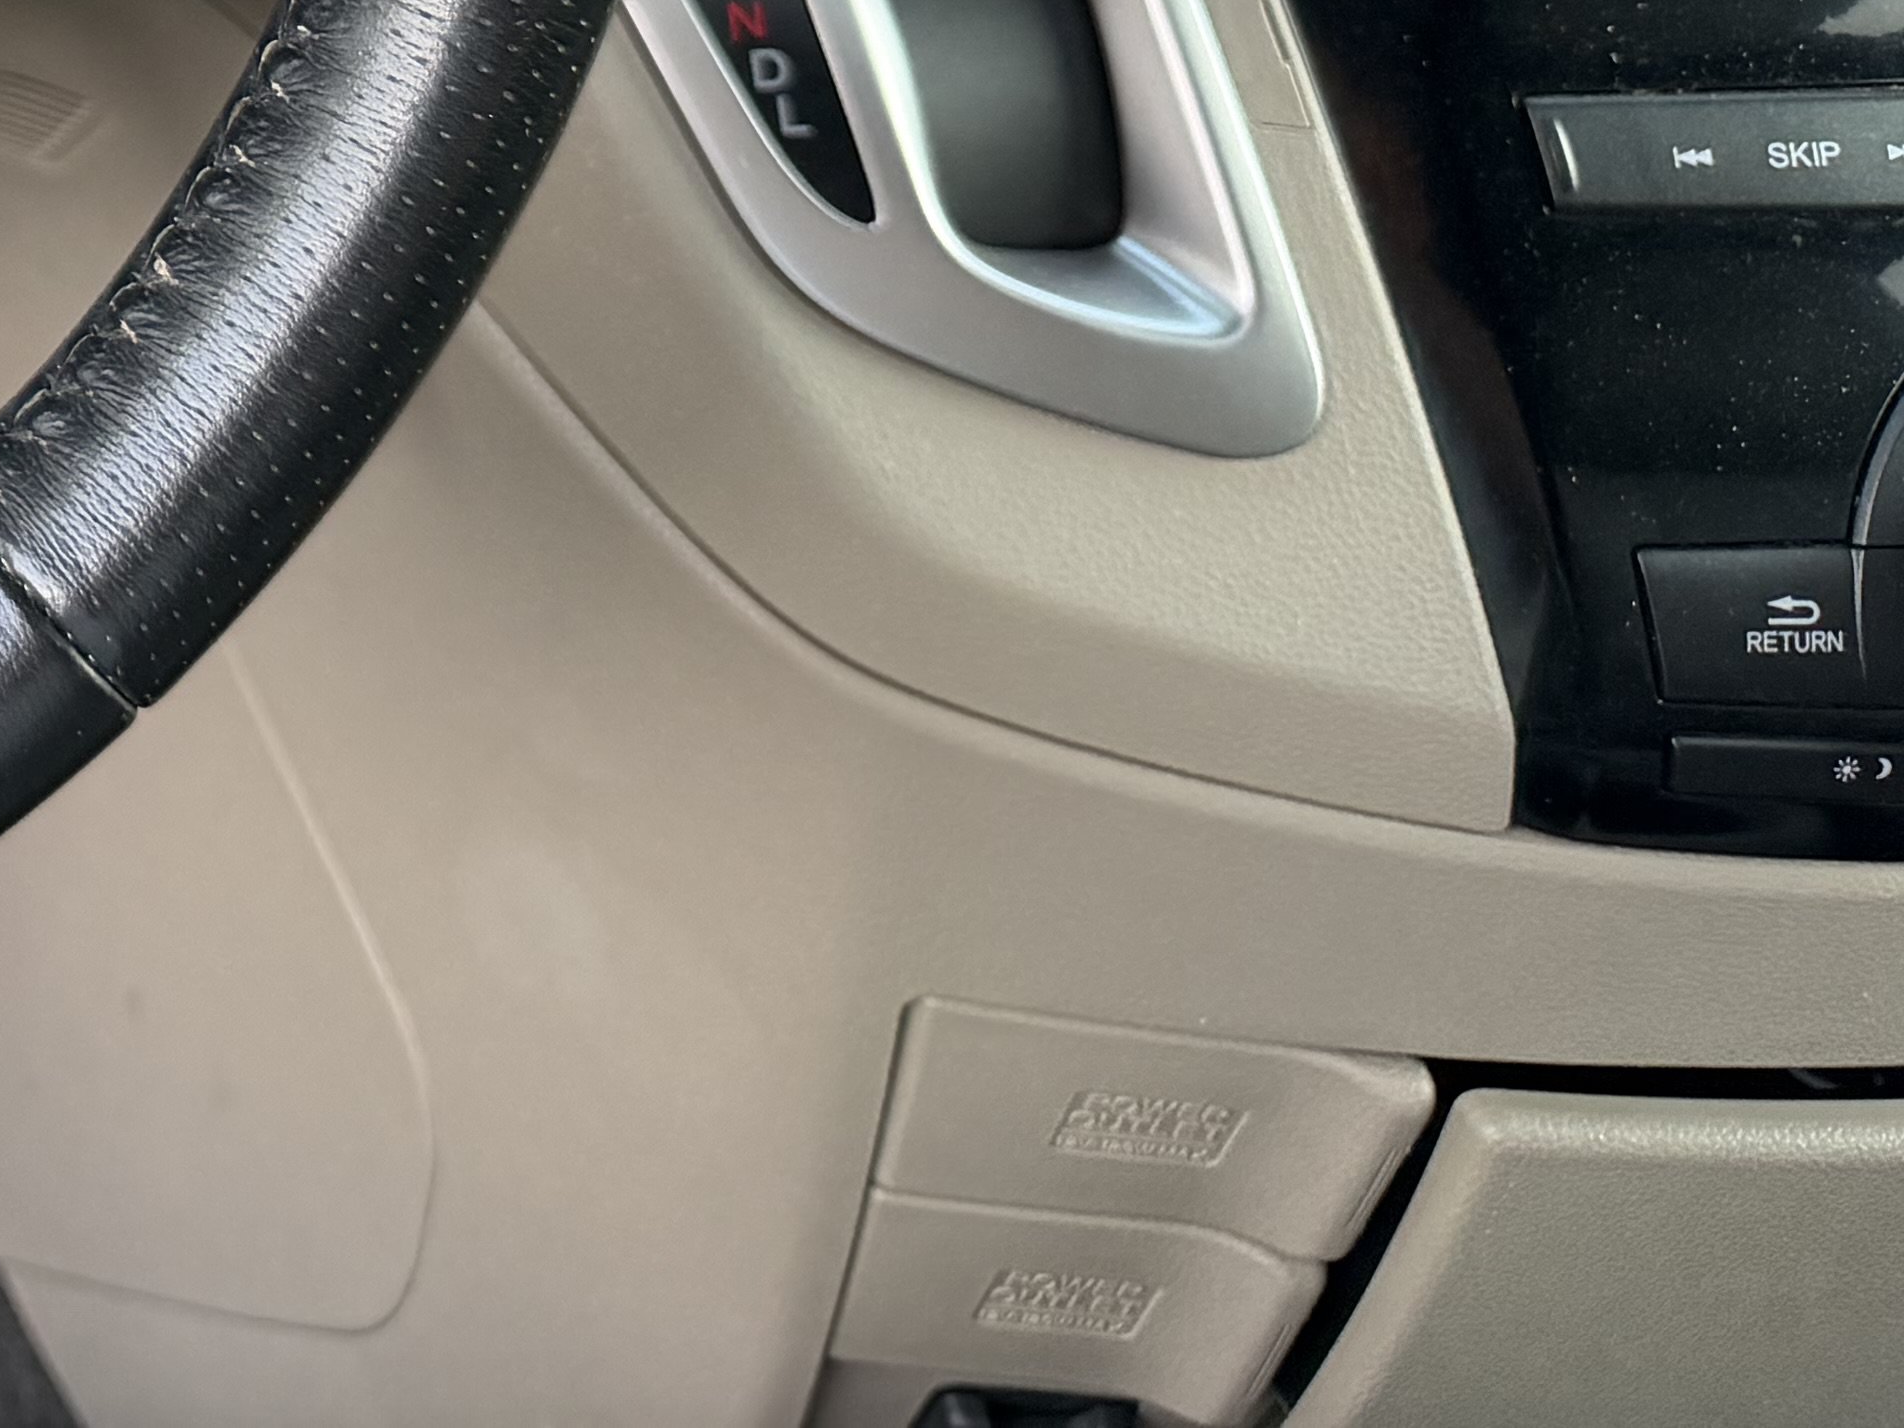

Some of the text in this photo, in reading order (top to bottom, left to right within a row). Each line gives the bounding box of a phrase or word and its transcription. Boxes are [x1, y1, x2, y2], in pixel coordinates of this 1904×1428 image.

[726, 1, 768, 41] N
[748, 47, 792, 93] D
[775, 93, 818, 139] L
[1766, 140, 1842, 170] SKIP
[1745, 630, 1845, 655] RETURN
